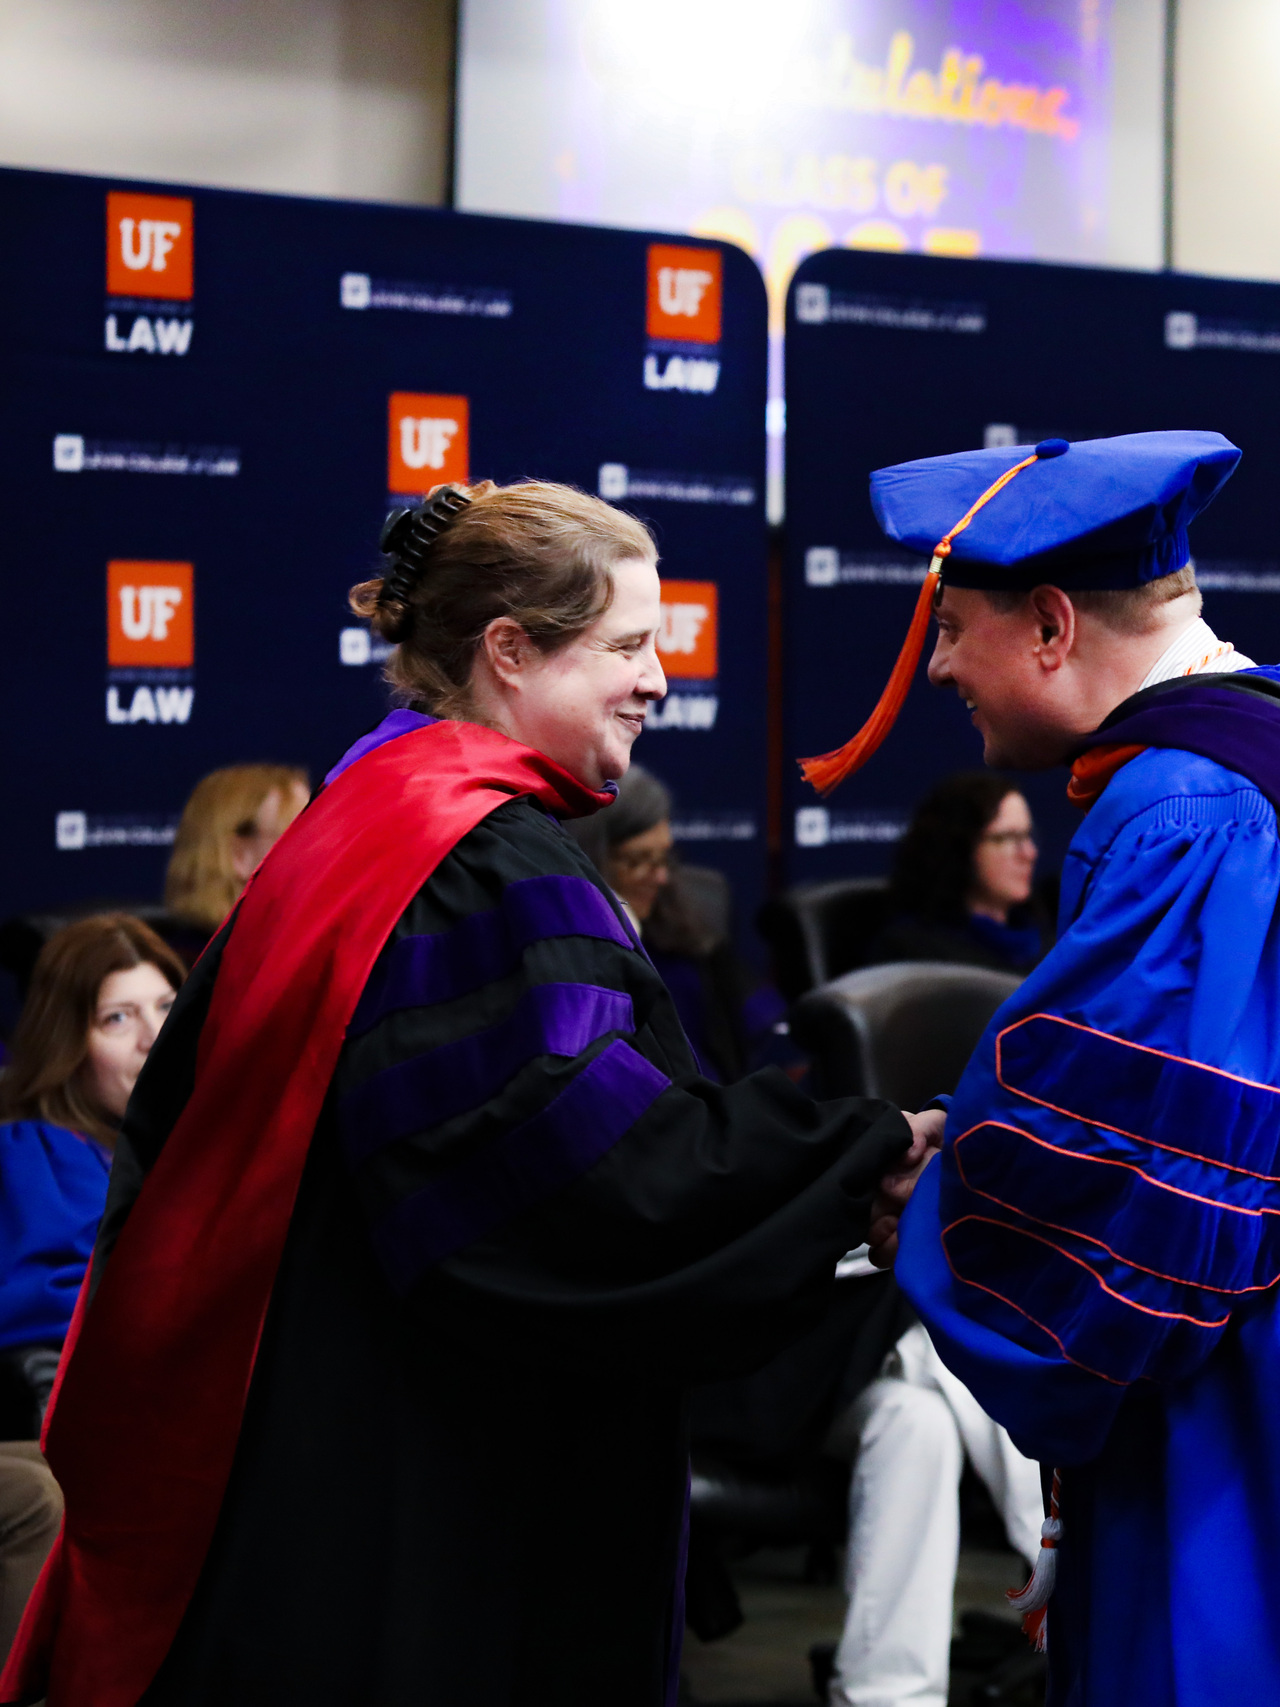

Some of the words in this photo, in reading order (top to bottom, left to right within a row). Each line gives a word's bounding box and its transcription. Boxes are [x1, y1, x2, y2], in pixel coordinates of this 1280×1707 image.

[884, 160, 948, 218] OF
[119, 217, 182, 272] UF
[657, 266, 714, 318] UF
[105, 314, 194, 356] LAW
[643, 353, 721, 395] LAW
[400, 415, 459, 470] UF
[119, 584, 183, 641] UF
[657, 602, 708, 655] UF
[106, 685, 194, 725] LAW
